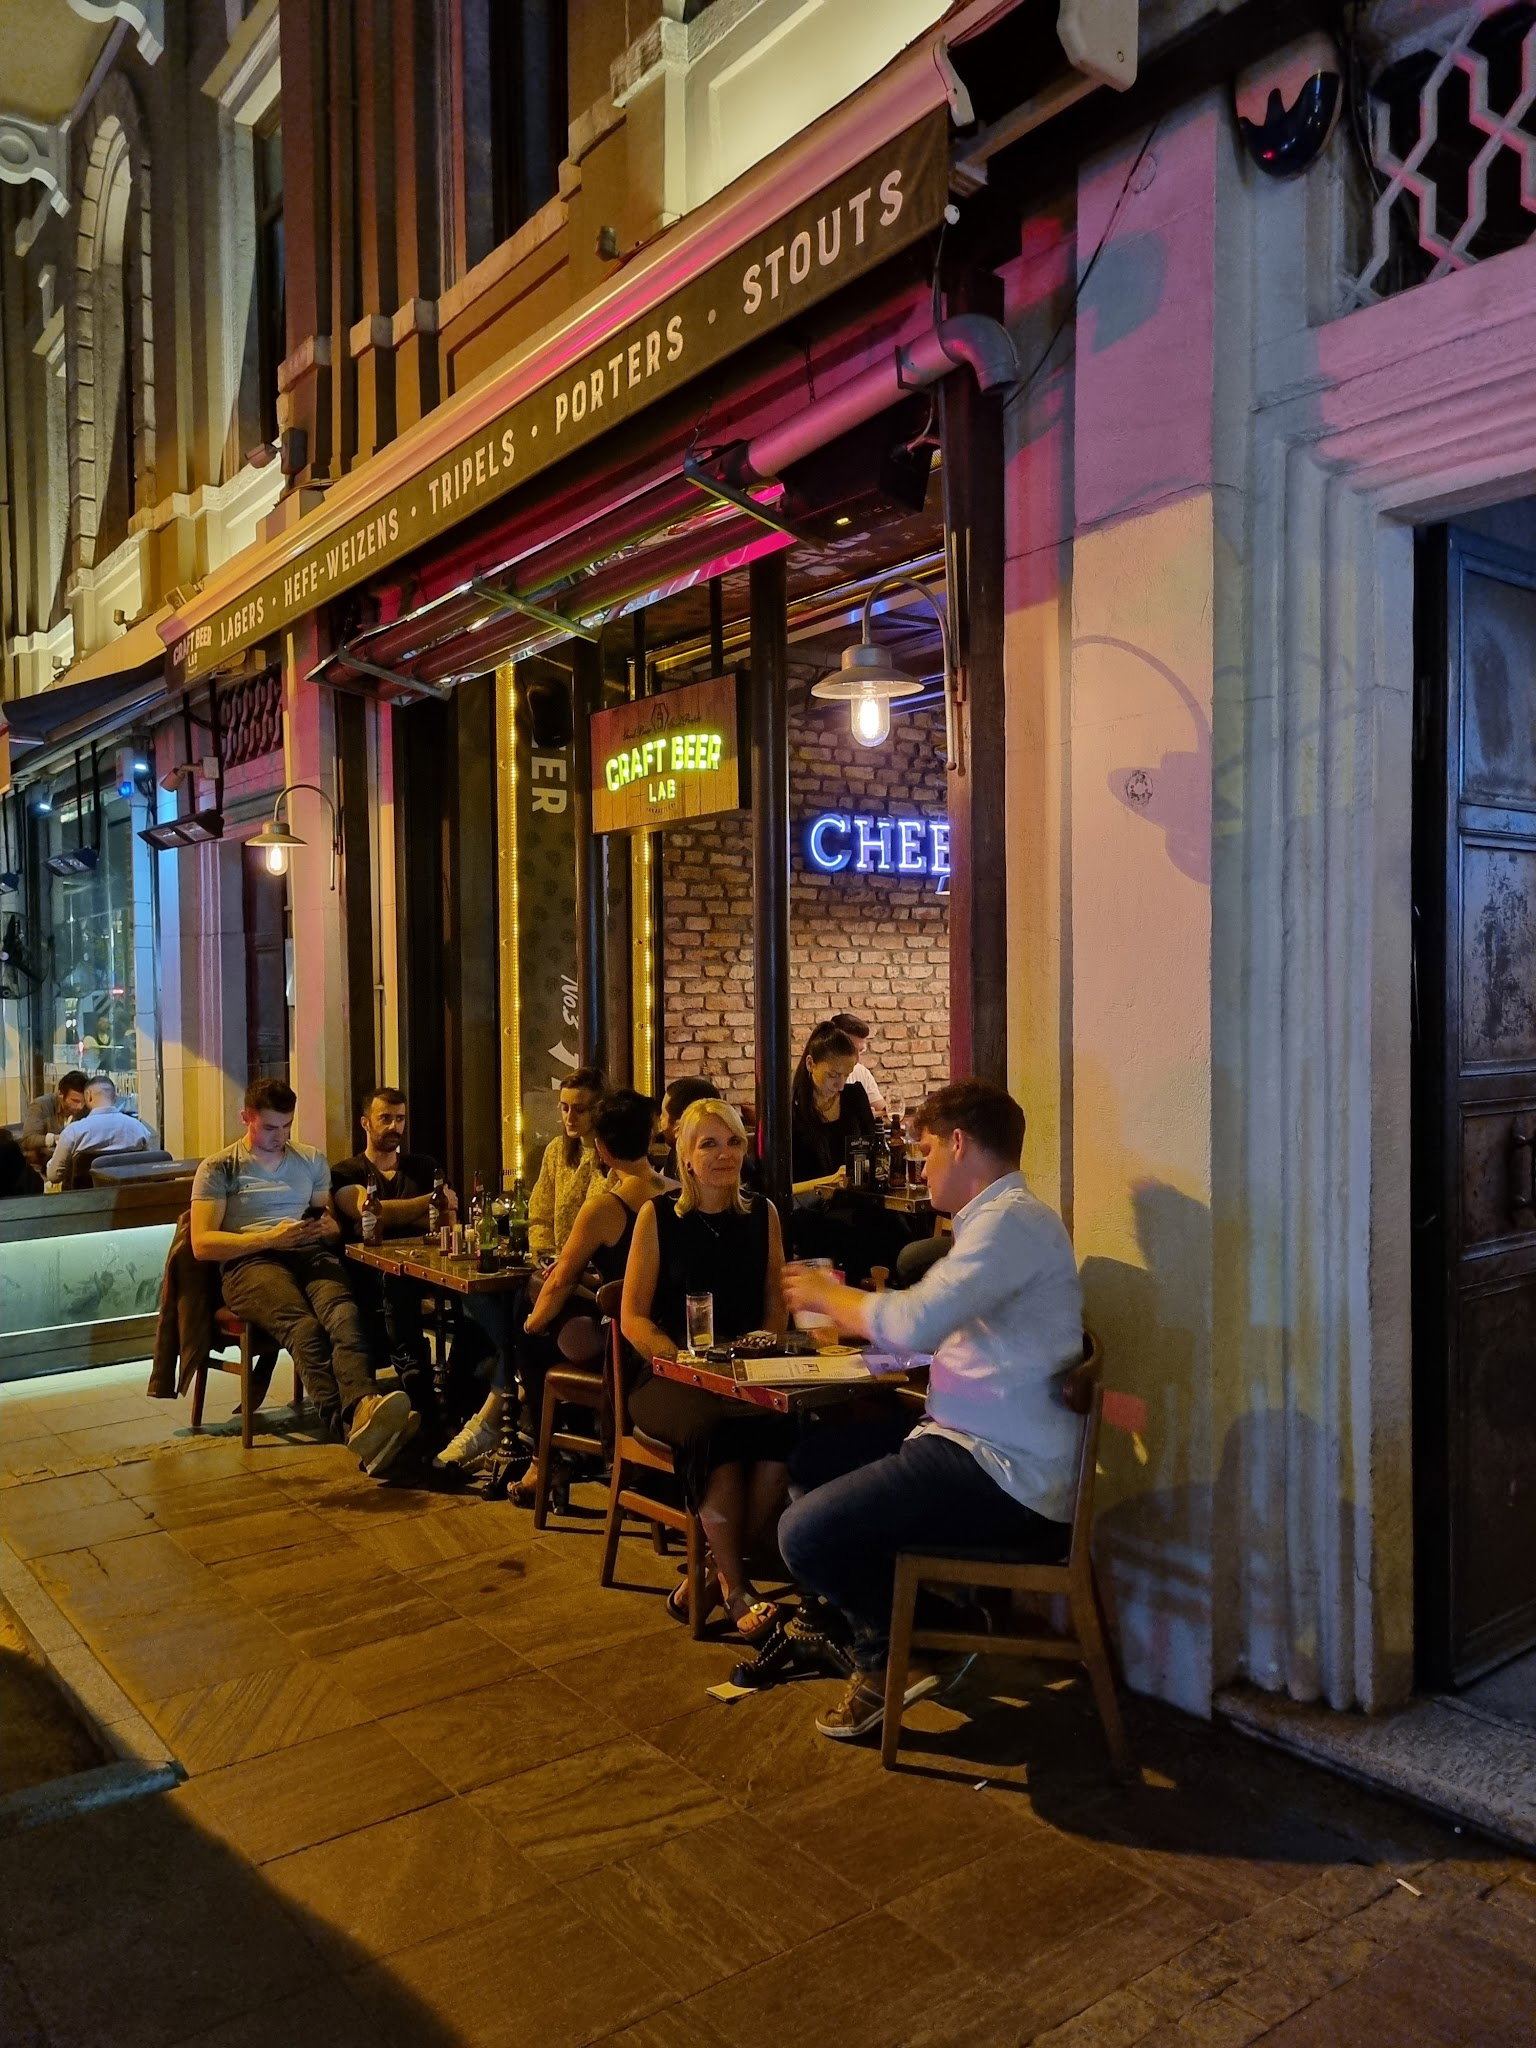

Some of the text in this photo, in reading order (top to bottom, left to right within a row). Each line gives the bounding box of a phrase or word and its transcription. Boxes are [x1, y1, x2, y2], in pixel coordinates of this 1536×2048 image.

[220, 169, 904, 647] LAGERS HEFE-WEIZENS TRIPELS PORTERS STOUTS
[605, 733, 722, 791] CRAFT BEER
[648, 778, 676, 803] LAB
